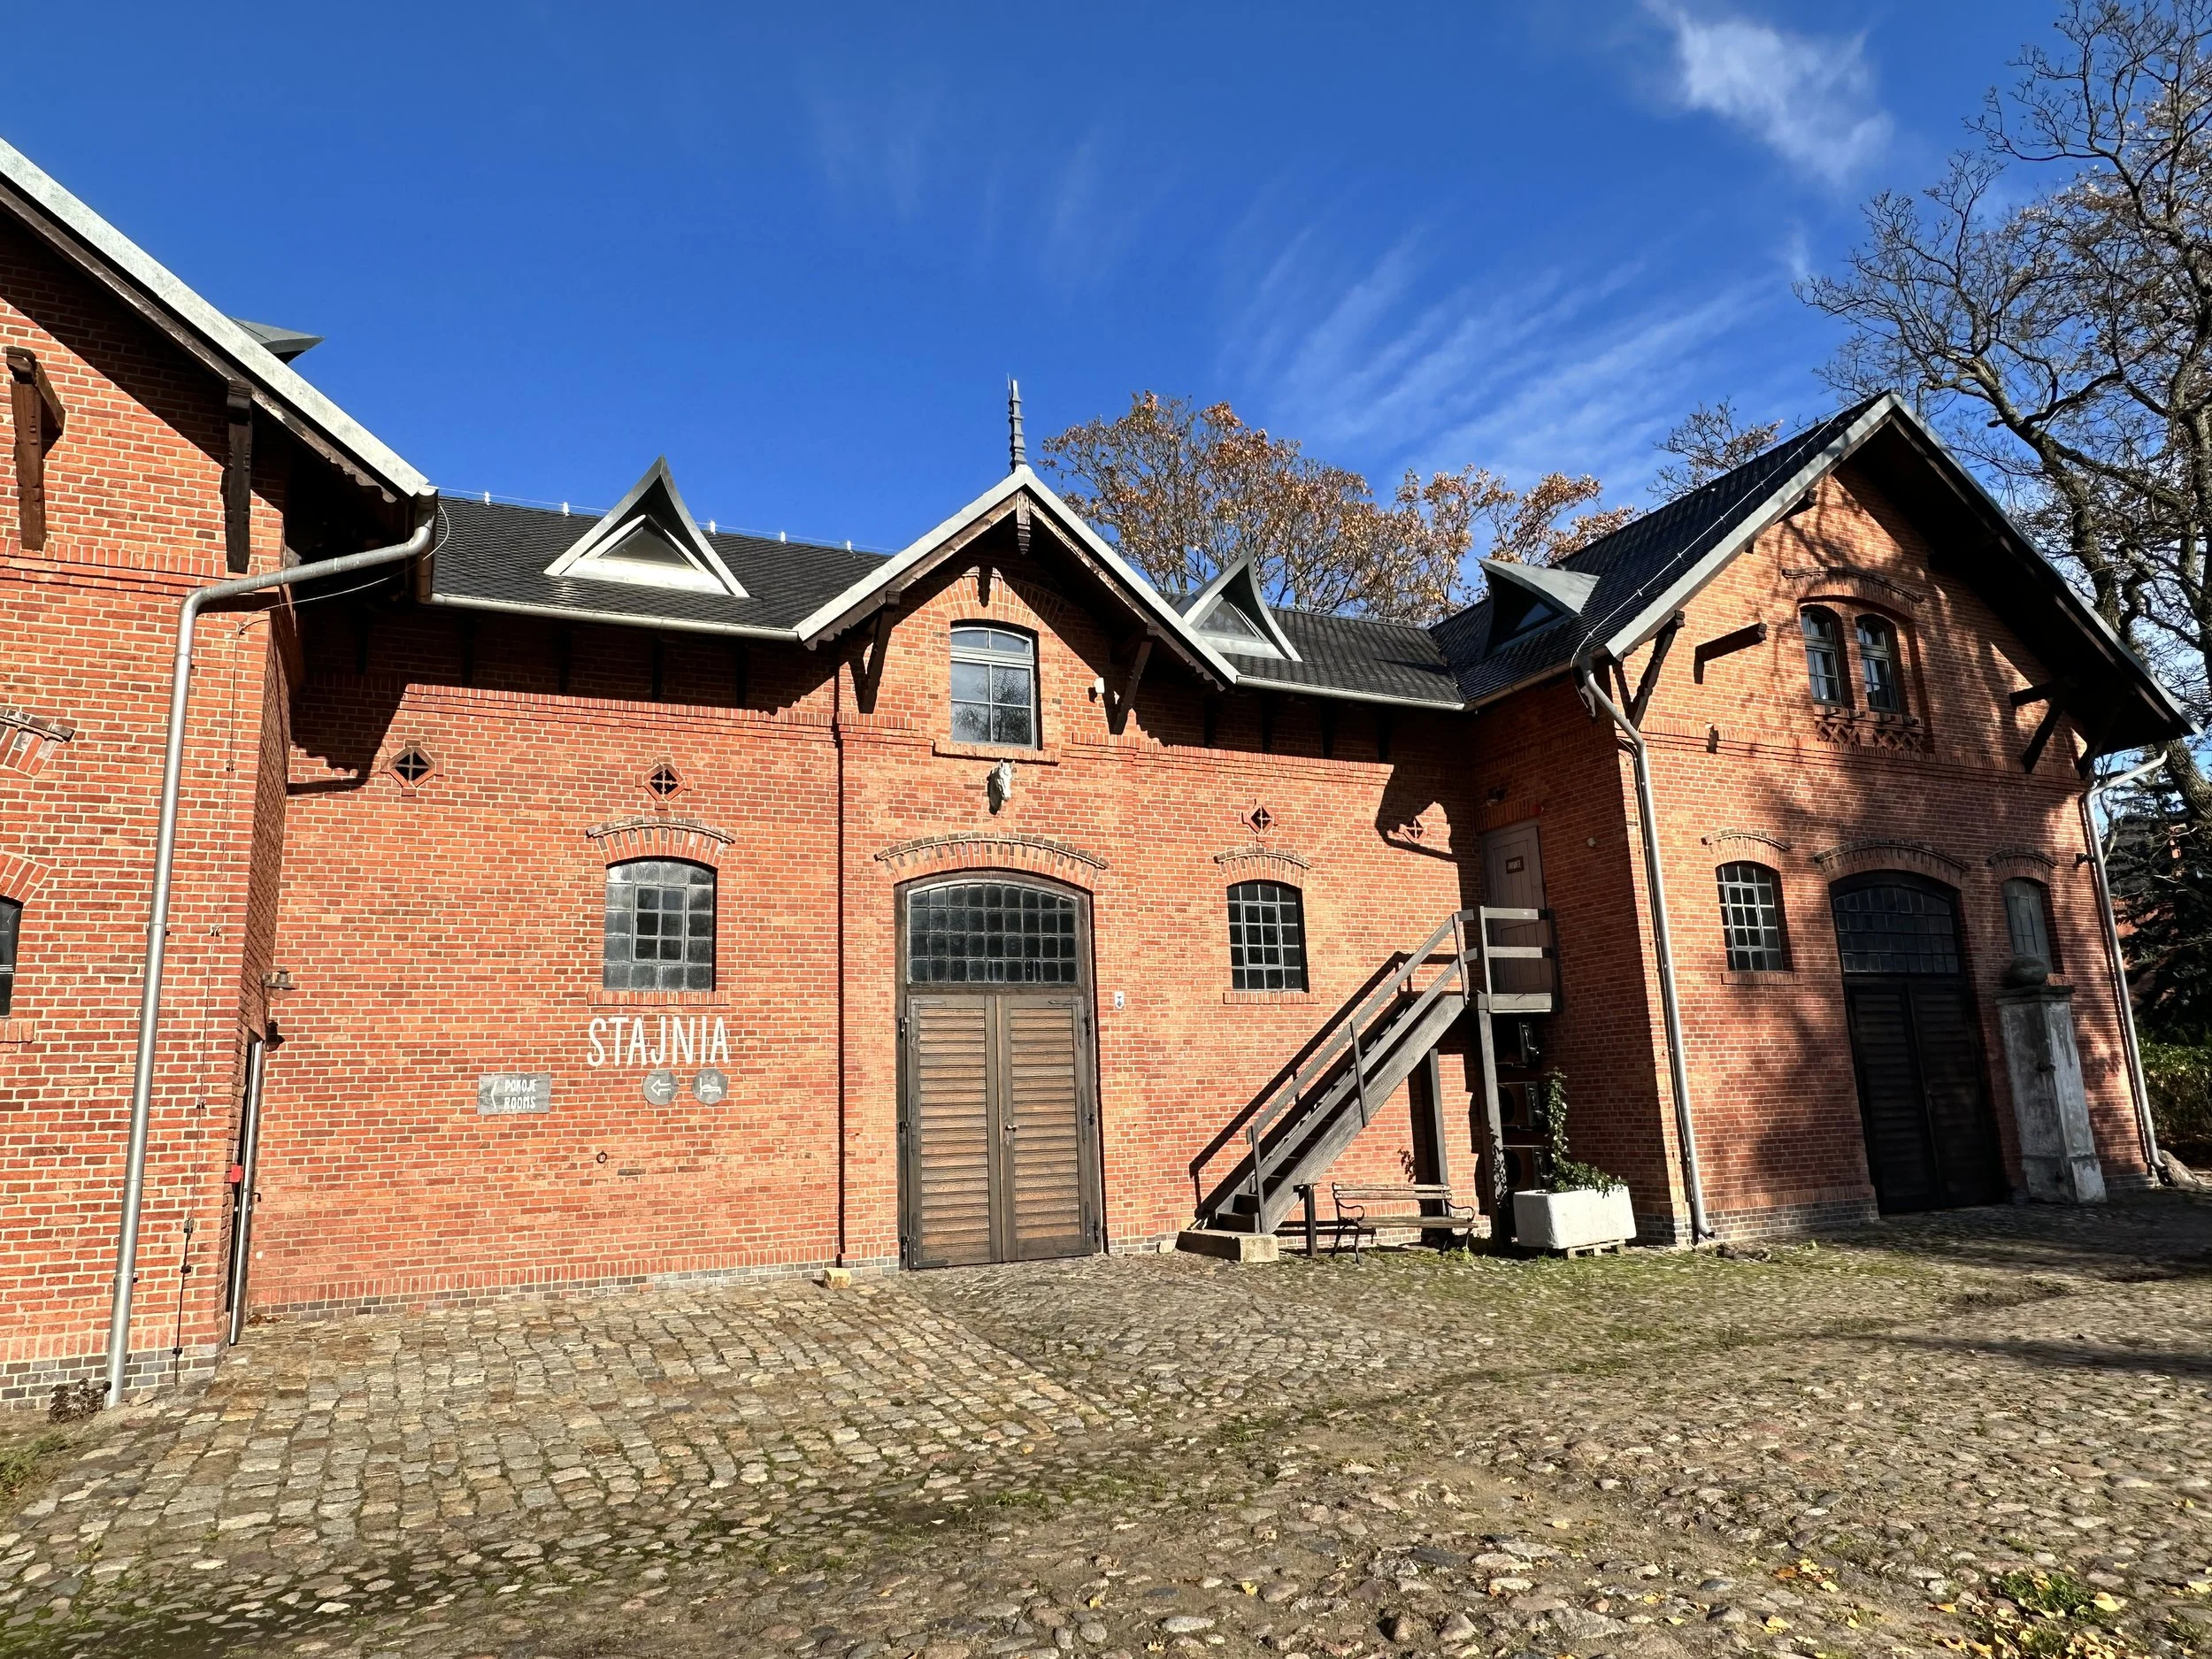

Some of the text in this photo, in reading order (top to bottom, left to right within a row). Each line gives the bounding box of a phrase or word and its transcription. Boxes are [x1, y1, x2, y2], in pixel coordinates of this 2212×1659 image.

[586, 1015, 729, 1067] STAJNIA
[504, 1079, 537, 1093] POKOJE
[503, 1095, 536, 1110] ROOMS
